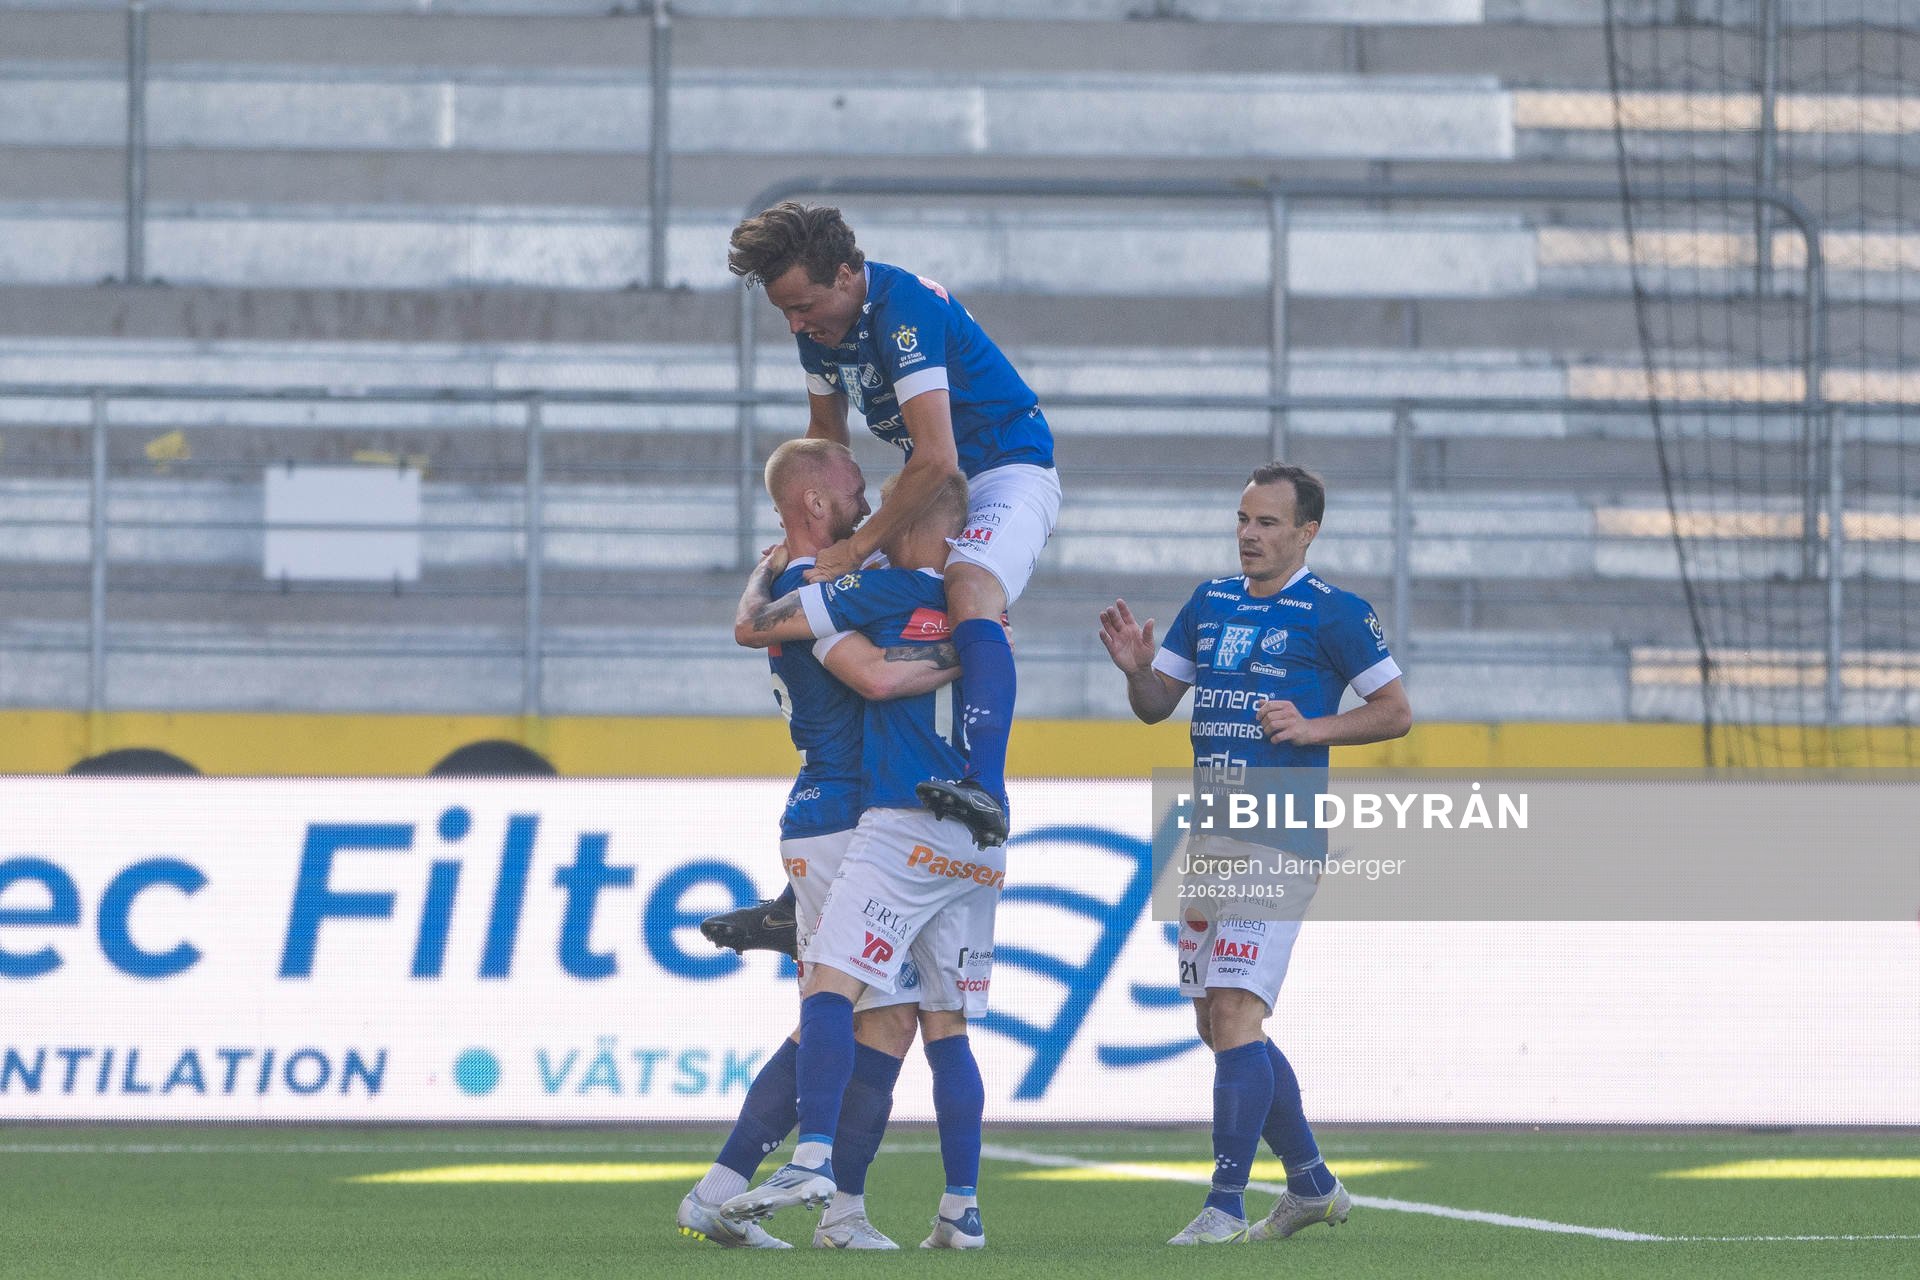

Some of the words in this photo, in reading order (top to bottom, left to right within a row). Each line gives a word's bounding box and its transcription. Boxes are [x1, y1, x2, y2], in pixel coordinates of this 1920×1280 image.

[960, 527, 993, 541] AXI
[1224, 625, 1254, 640] EFF
[1219, 640, 1252, 653] EKT
[277, 804, 797, 981] Filte
[1181, 960, 1199, 984] 21
[1218, 967, 1243, 975] CRAFT
[0, 1046, 390, 1096] NTILATION
